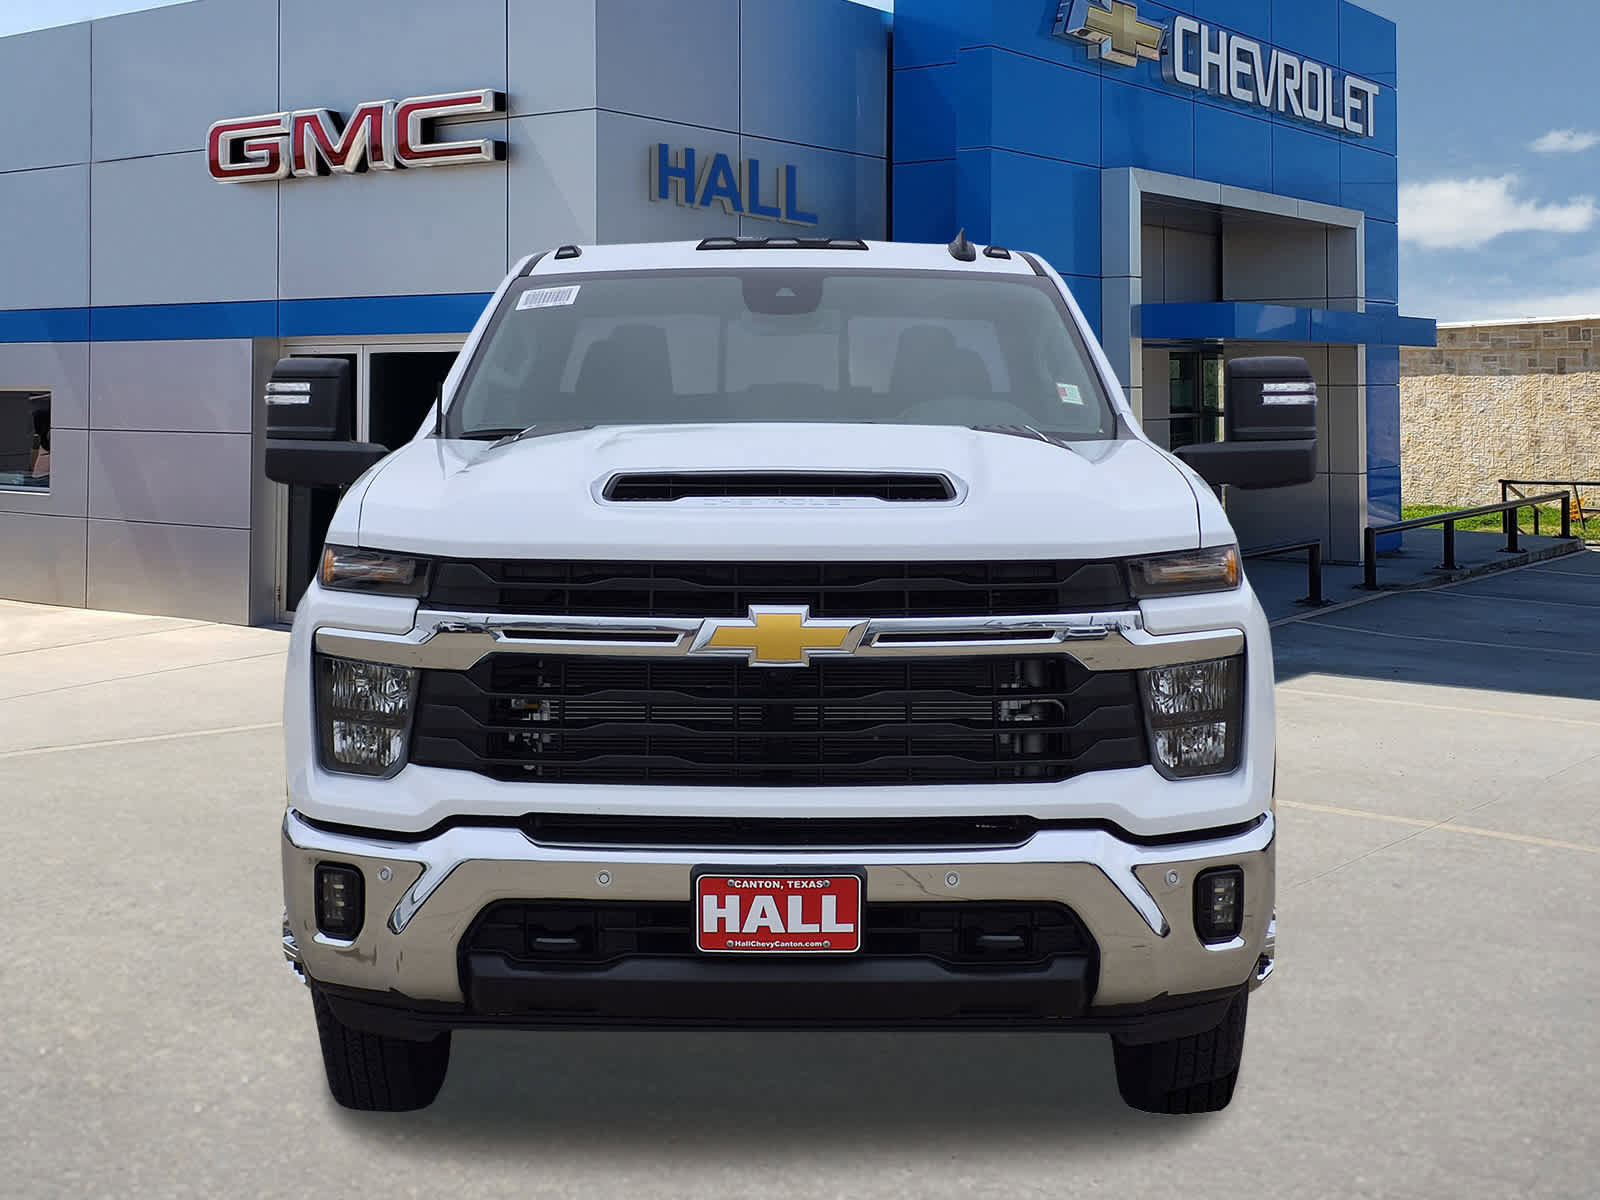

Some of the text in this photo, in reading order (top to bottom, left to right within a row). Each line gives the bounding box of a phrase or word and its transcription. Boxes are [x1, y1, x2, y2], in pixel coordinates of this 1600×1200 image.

[1173, 15, 1380, 137] CHEVROLET
[206, 88, 504, 184] GMC
[652, 143, 818, 226] HALL
[702, 895, 854, 933] HALL
[734, 880, 824, 890] CANTON, TEXAS
[734, 940, 823, 949] HallChevyCanton.com
